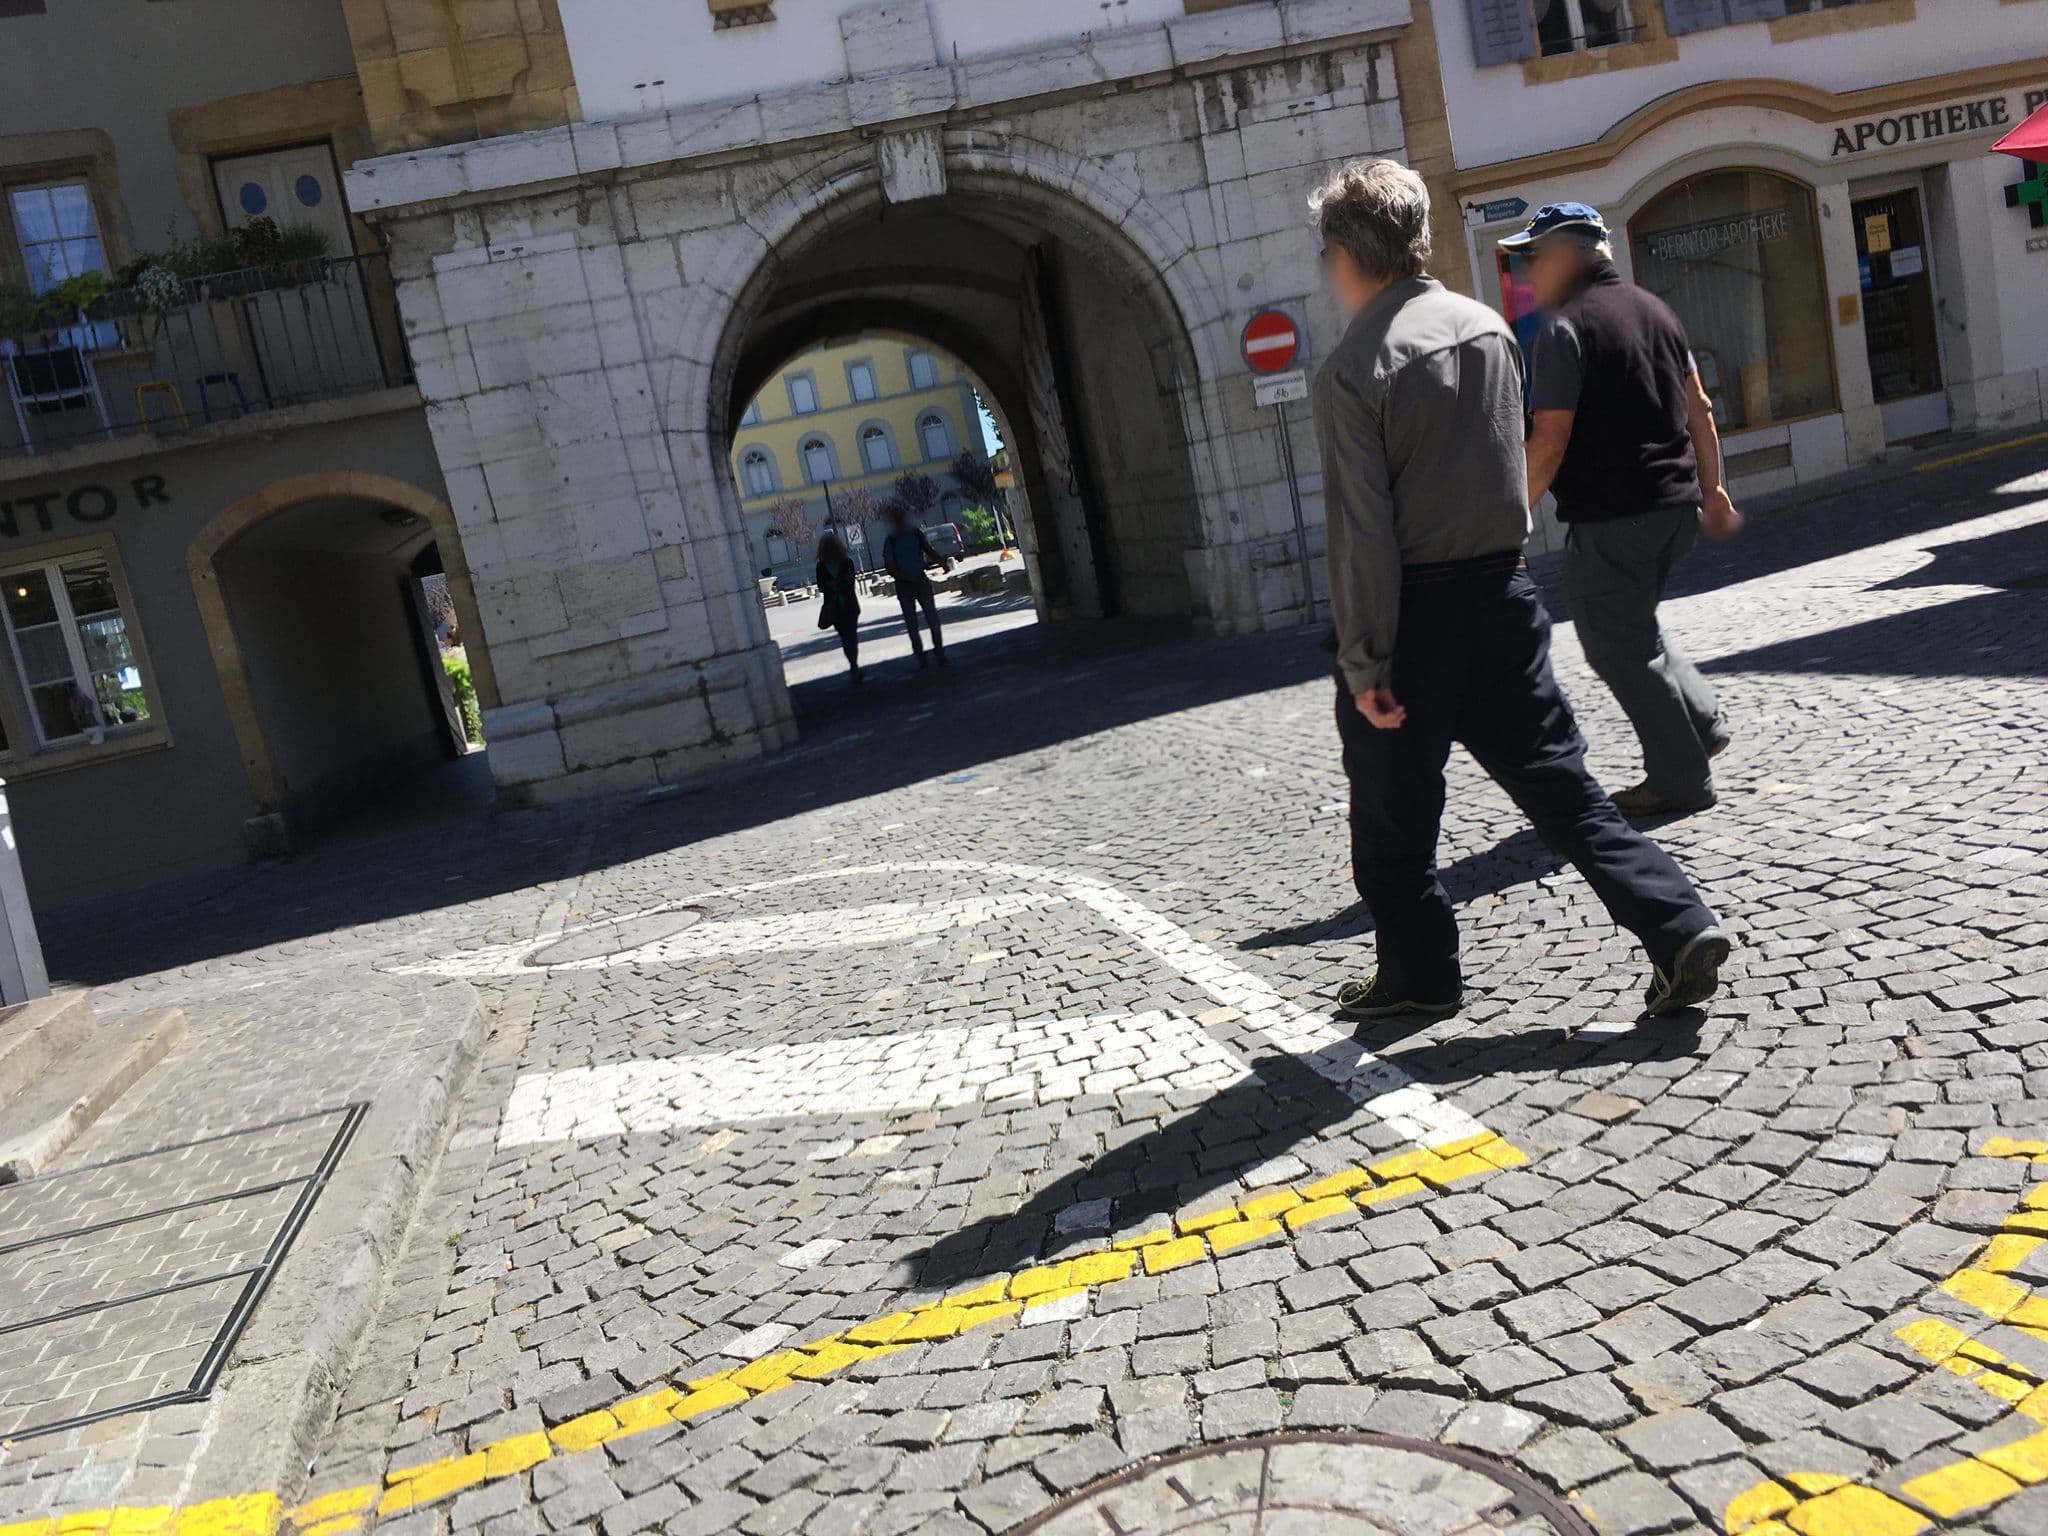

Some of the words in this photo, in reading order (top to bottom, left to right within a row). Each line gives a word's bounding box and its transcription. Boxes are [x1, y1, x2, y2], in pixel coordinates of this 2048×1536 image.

[1831, 97, 2009, 156] APOTHEKE
[2024, 89, 2048, 116] P
[1658, 212, 1787, 260] BERNTOR-APOTHEKE
